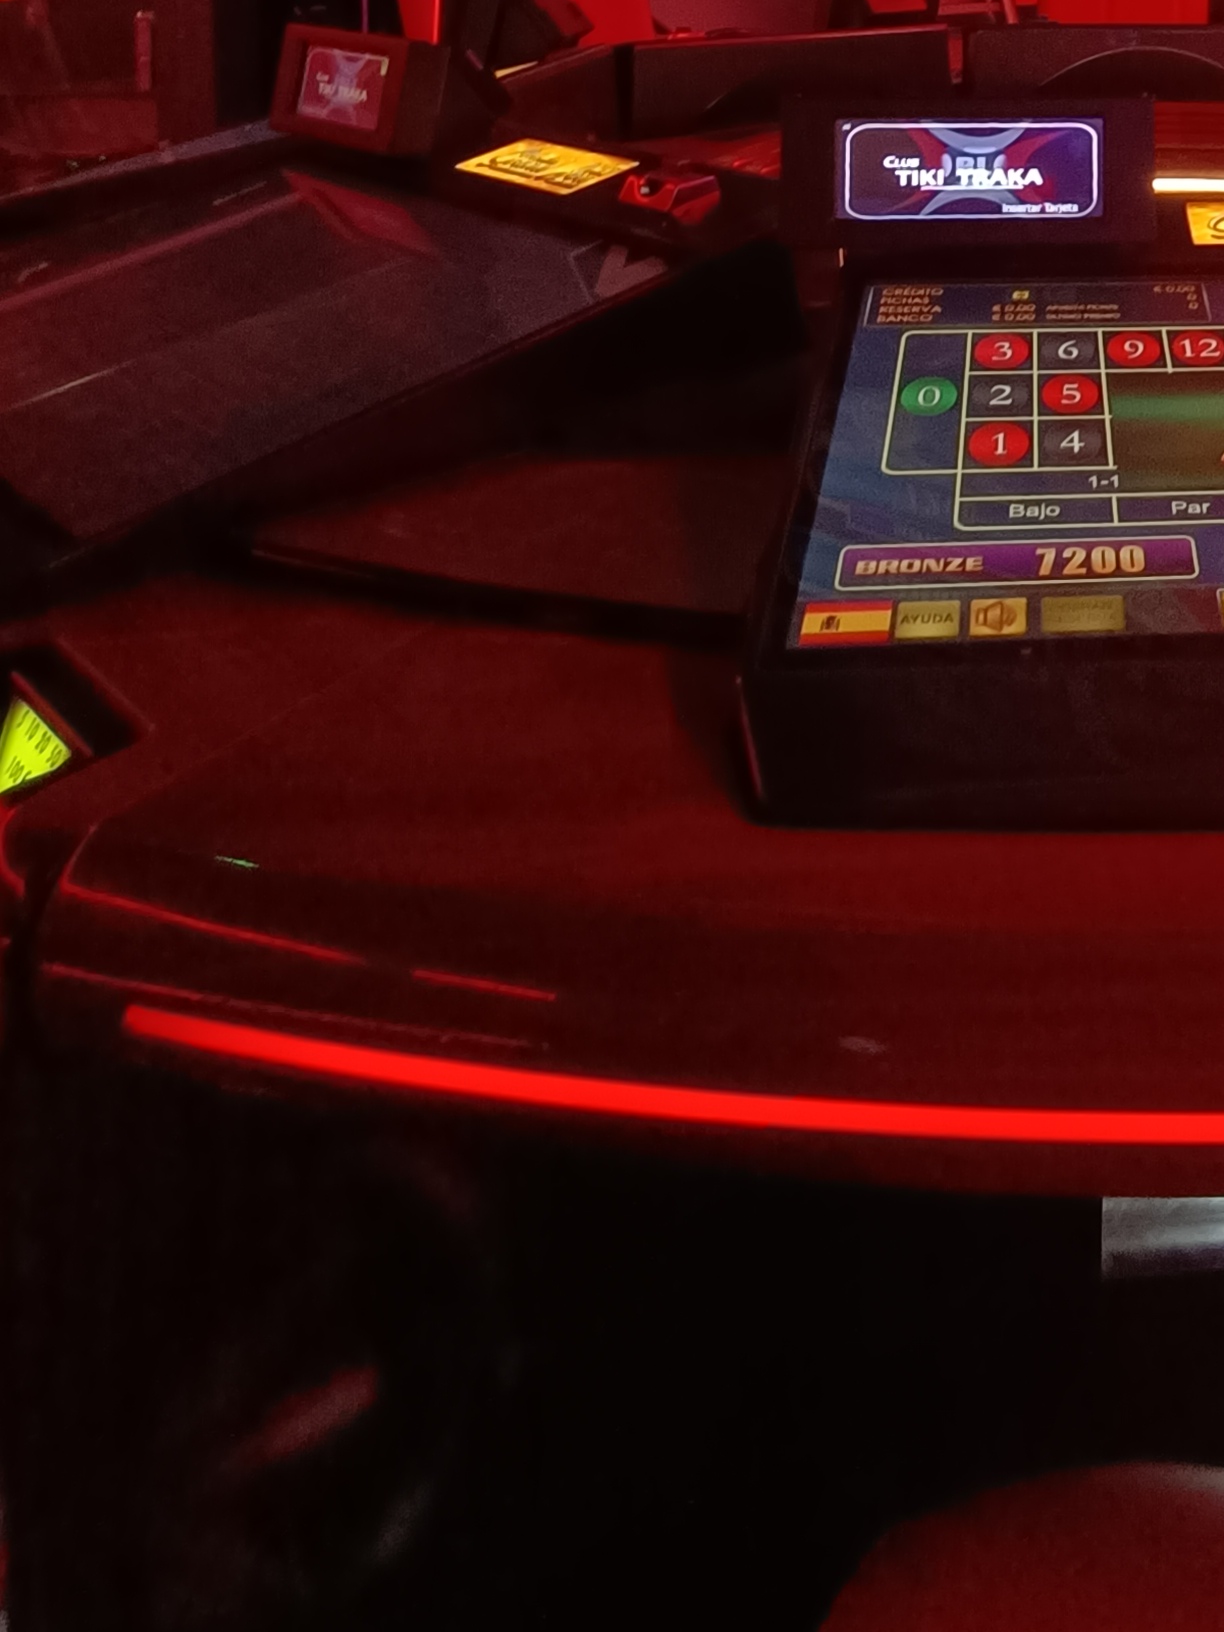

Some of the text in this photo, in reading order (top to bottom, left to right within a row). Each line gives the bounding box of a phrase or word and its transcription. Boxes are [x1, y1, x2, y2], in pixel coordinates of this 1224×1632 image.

[895, 168, 1043, 186] TIKI TRAKA
[1002, 202, 1078, 213] Insertar Tarjeta
[877, 314, 933, 323] BANCO
[879, 305, 942, 313] RESERVA
[991, 341, 1013, 361] 3
[1058, 340, 1080, 361] 6
[1123, 339, 1145, 359] 9
[1179, 338, 1222, 358] 12
[916, 386, 942, 408] 0
[988, 385, 1013, 406] 2
[1060, 383, 1082, 405] 5
[992, 433, 1008, 455] 1
[1060, 431, 1085, 453] 4
[1008, 500, 1061, 520] Bajo
[1171, 499, 1211, 516] Par
[854, 545, 1147, 577] BRONZE 7200
[900, 612, 954, 626] AYUDA
